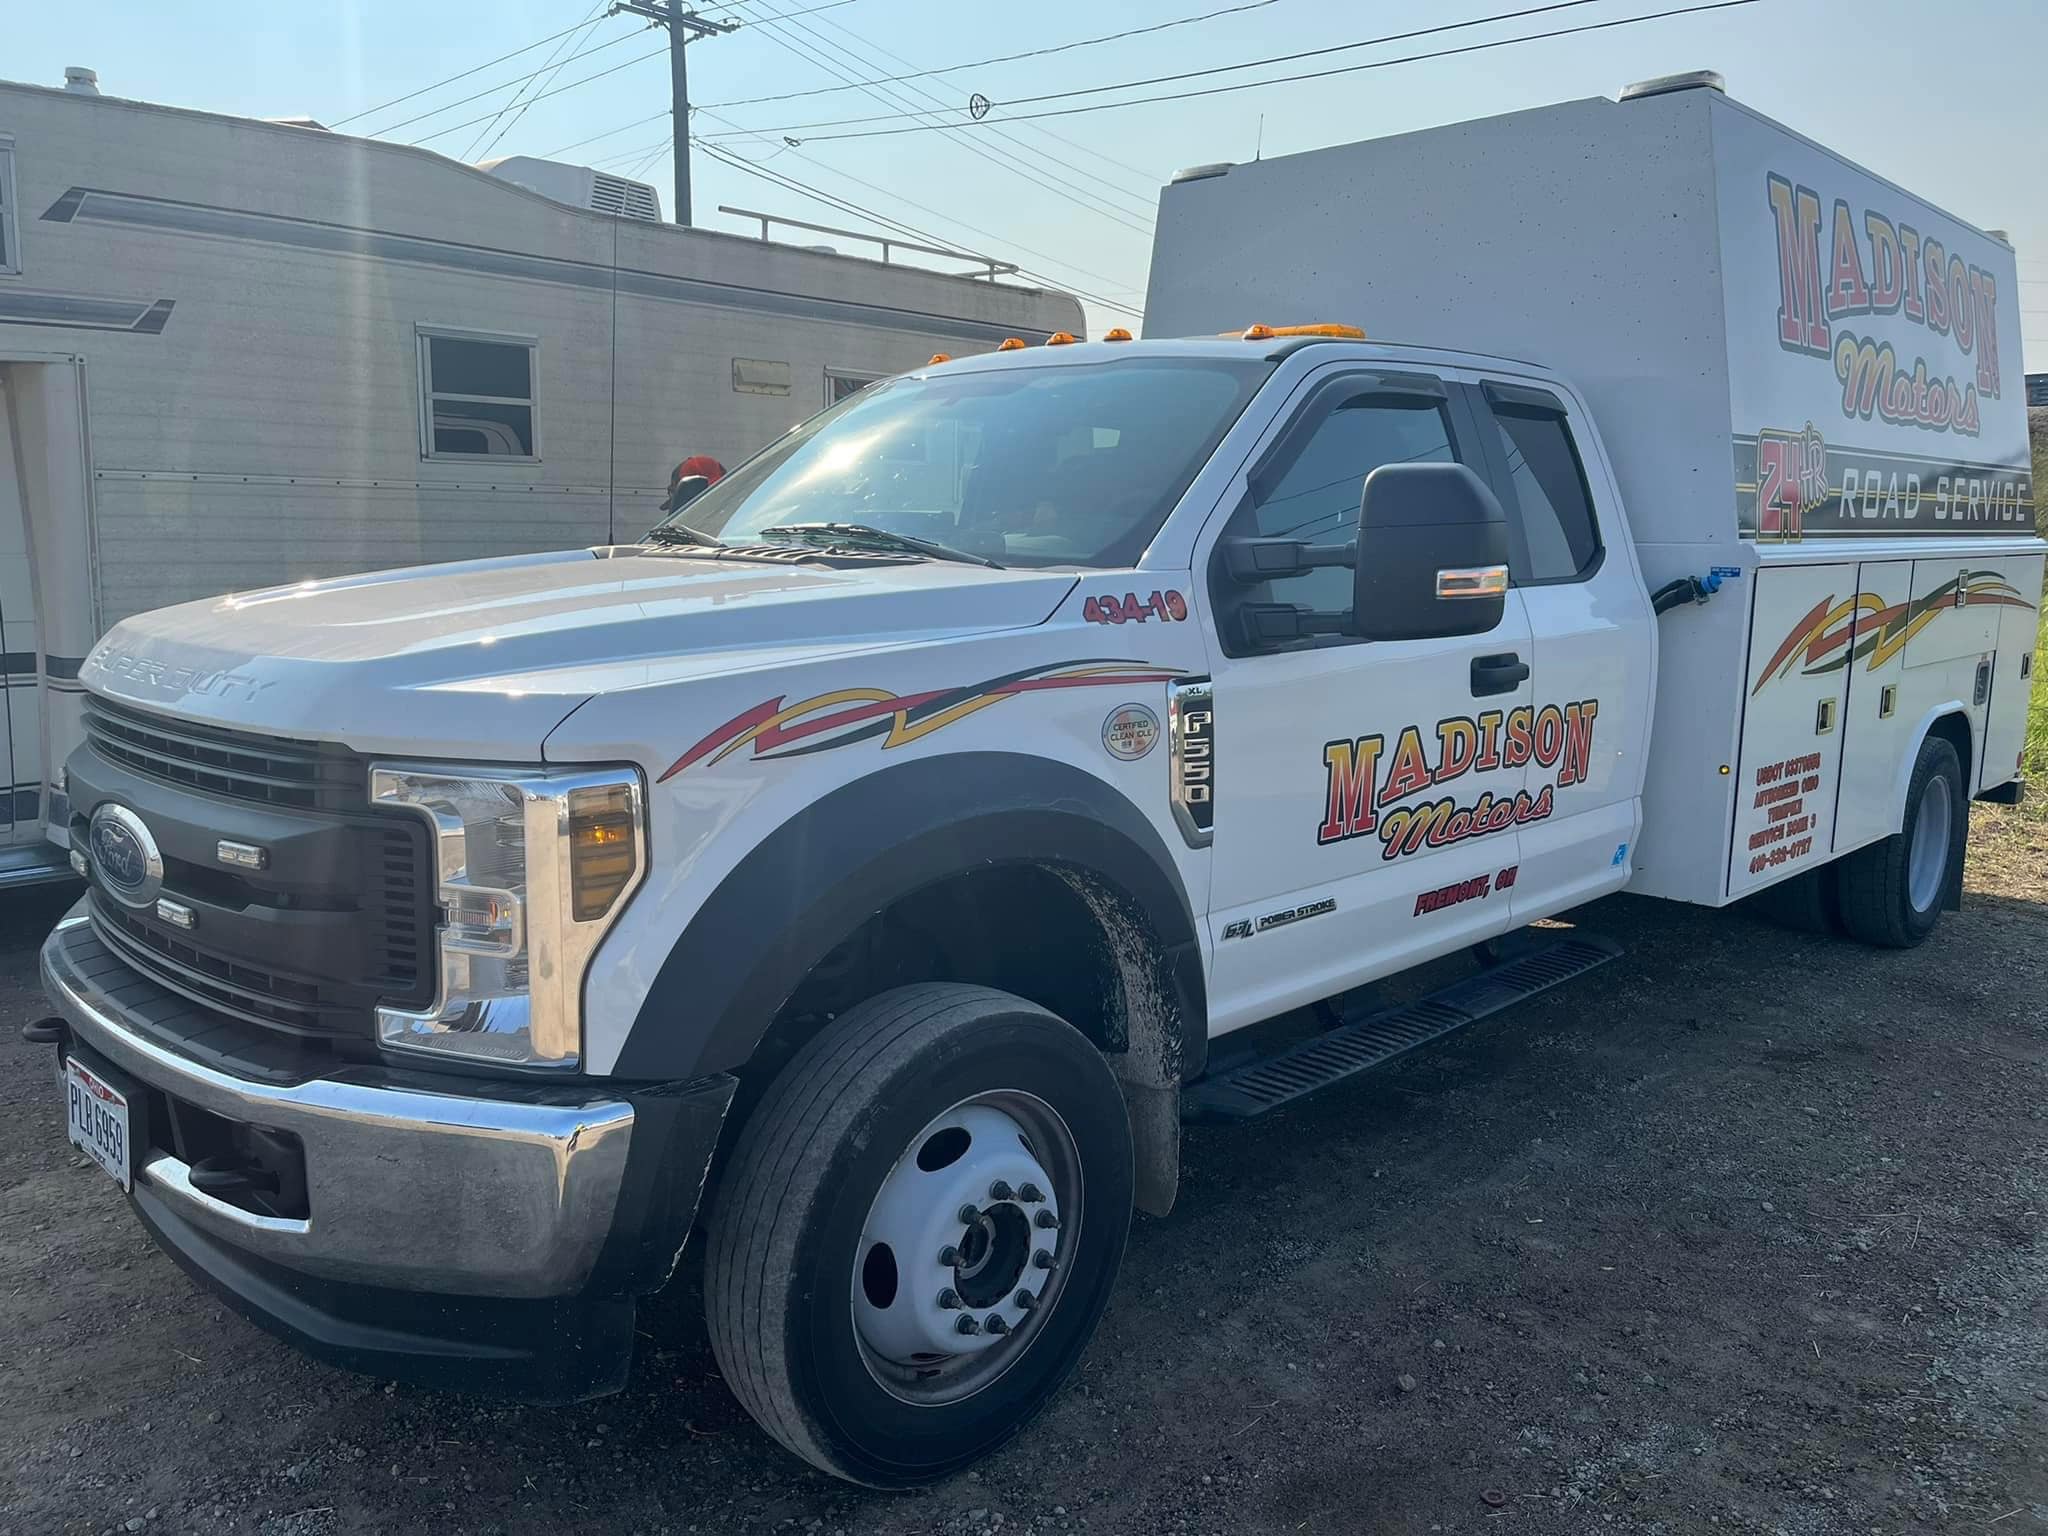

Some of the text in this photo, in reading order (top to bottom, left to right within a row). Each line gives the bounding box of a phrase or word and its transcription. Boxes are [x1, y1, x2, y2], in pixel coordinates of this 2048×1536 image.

[1767, 170, 2000, 399] MADISON
[1835, 330, 1980, 437] Motors
[1839, 468, 1921, 521] ROAD
[1935, 477, 2027, 522] SERVICE
[162, 667, 279, 703] DUTY
[1188, 687, 1203, 696] XL
[1111, 731, 1134, 741] CLEAN
[1113, 720, 1149, 731] CERTIFIED
[1318, 699, 1598, 845] MADISON
[1379, 785, 1553, 860] Motors
[99, 828, 131, 877] Ford
[1260, 910, 1296, 927] POWER
[1297, 898, 1335, 917] STROKE
[1413, 865, 1518, 917] FREMONT, OH
[71, 1082, 122, 1166] PLB 6959
